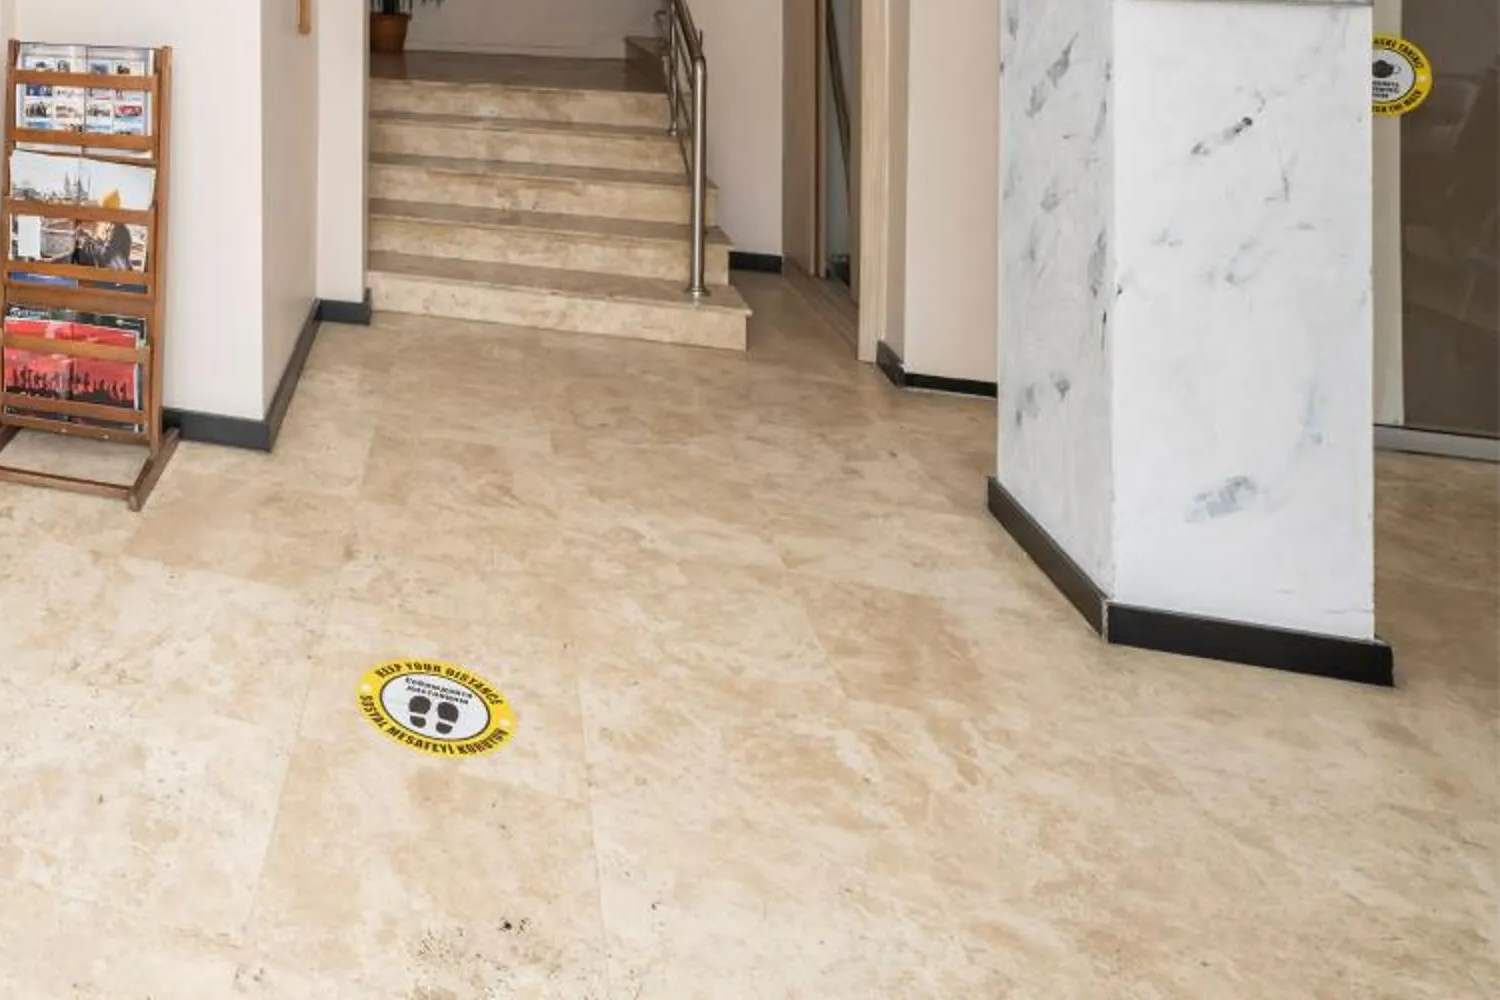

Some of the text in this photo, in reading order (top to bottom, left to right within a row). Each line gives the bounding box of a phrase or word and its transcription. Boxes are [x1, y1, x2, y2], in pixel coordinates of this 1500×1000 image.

[374, 663, 402, 678] KEEP
[404, 661, 441, 673] YOUR
[445, 666, 505, 705] DISTANCE
